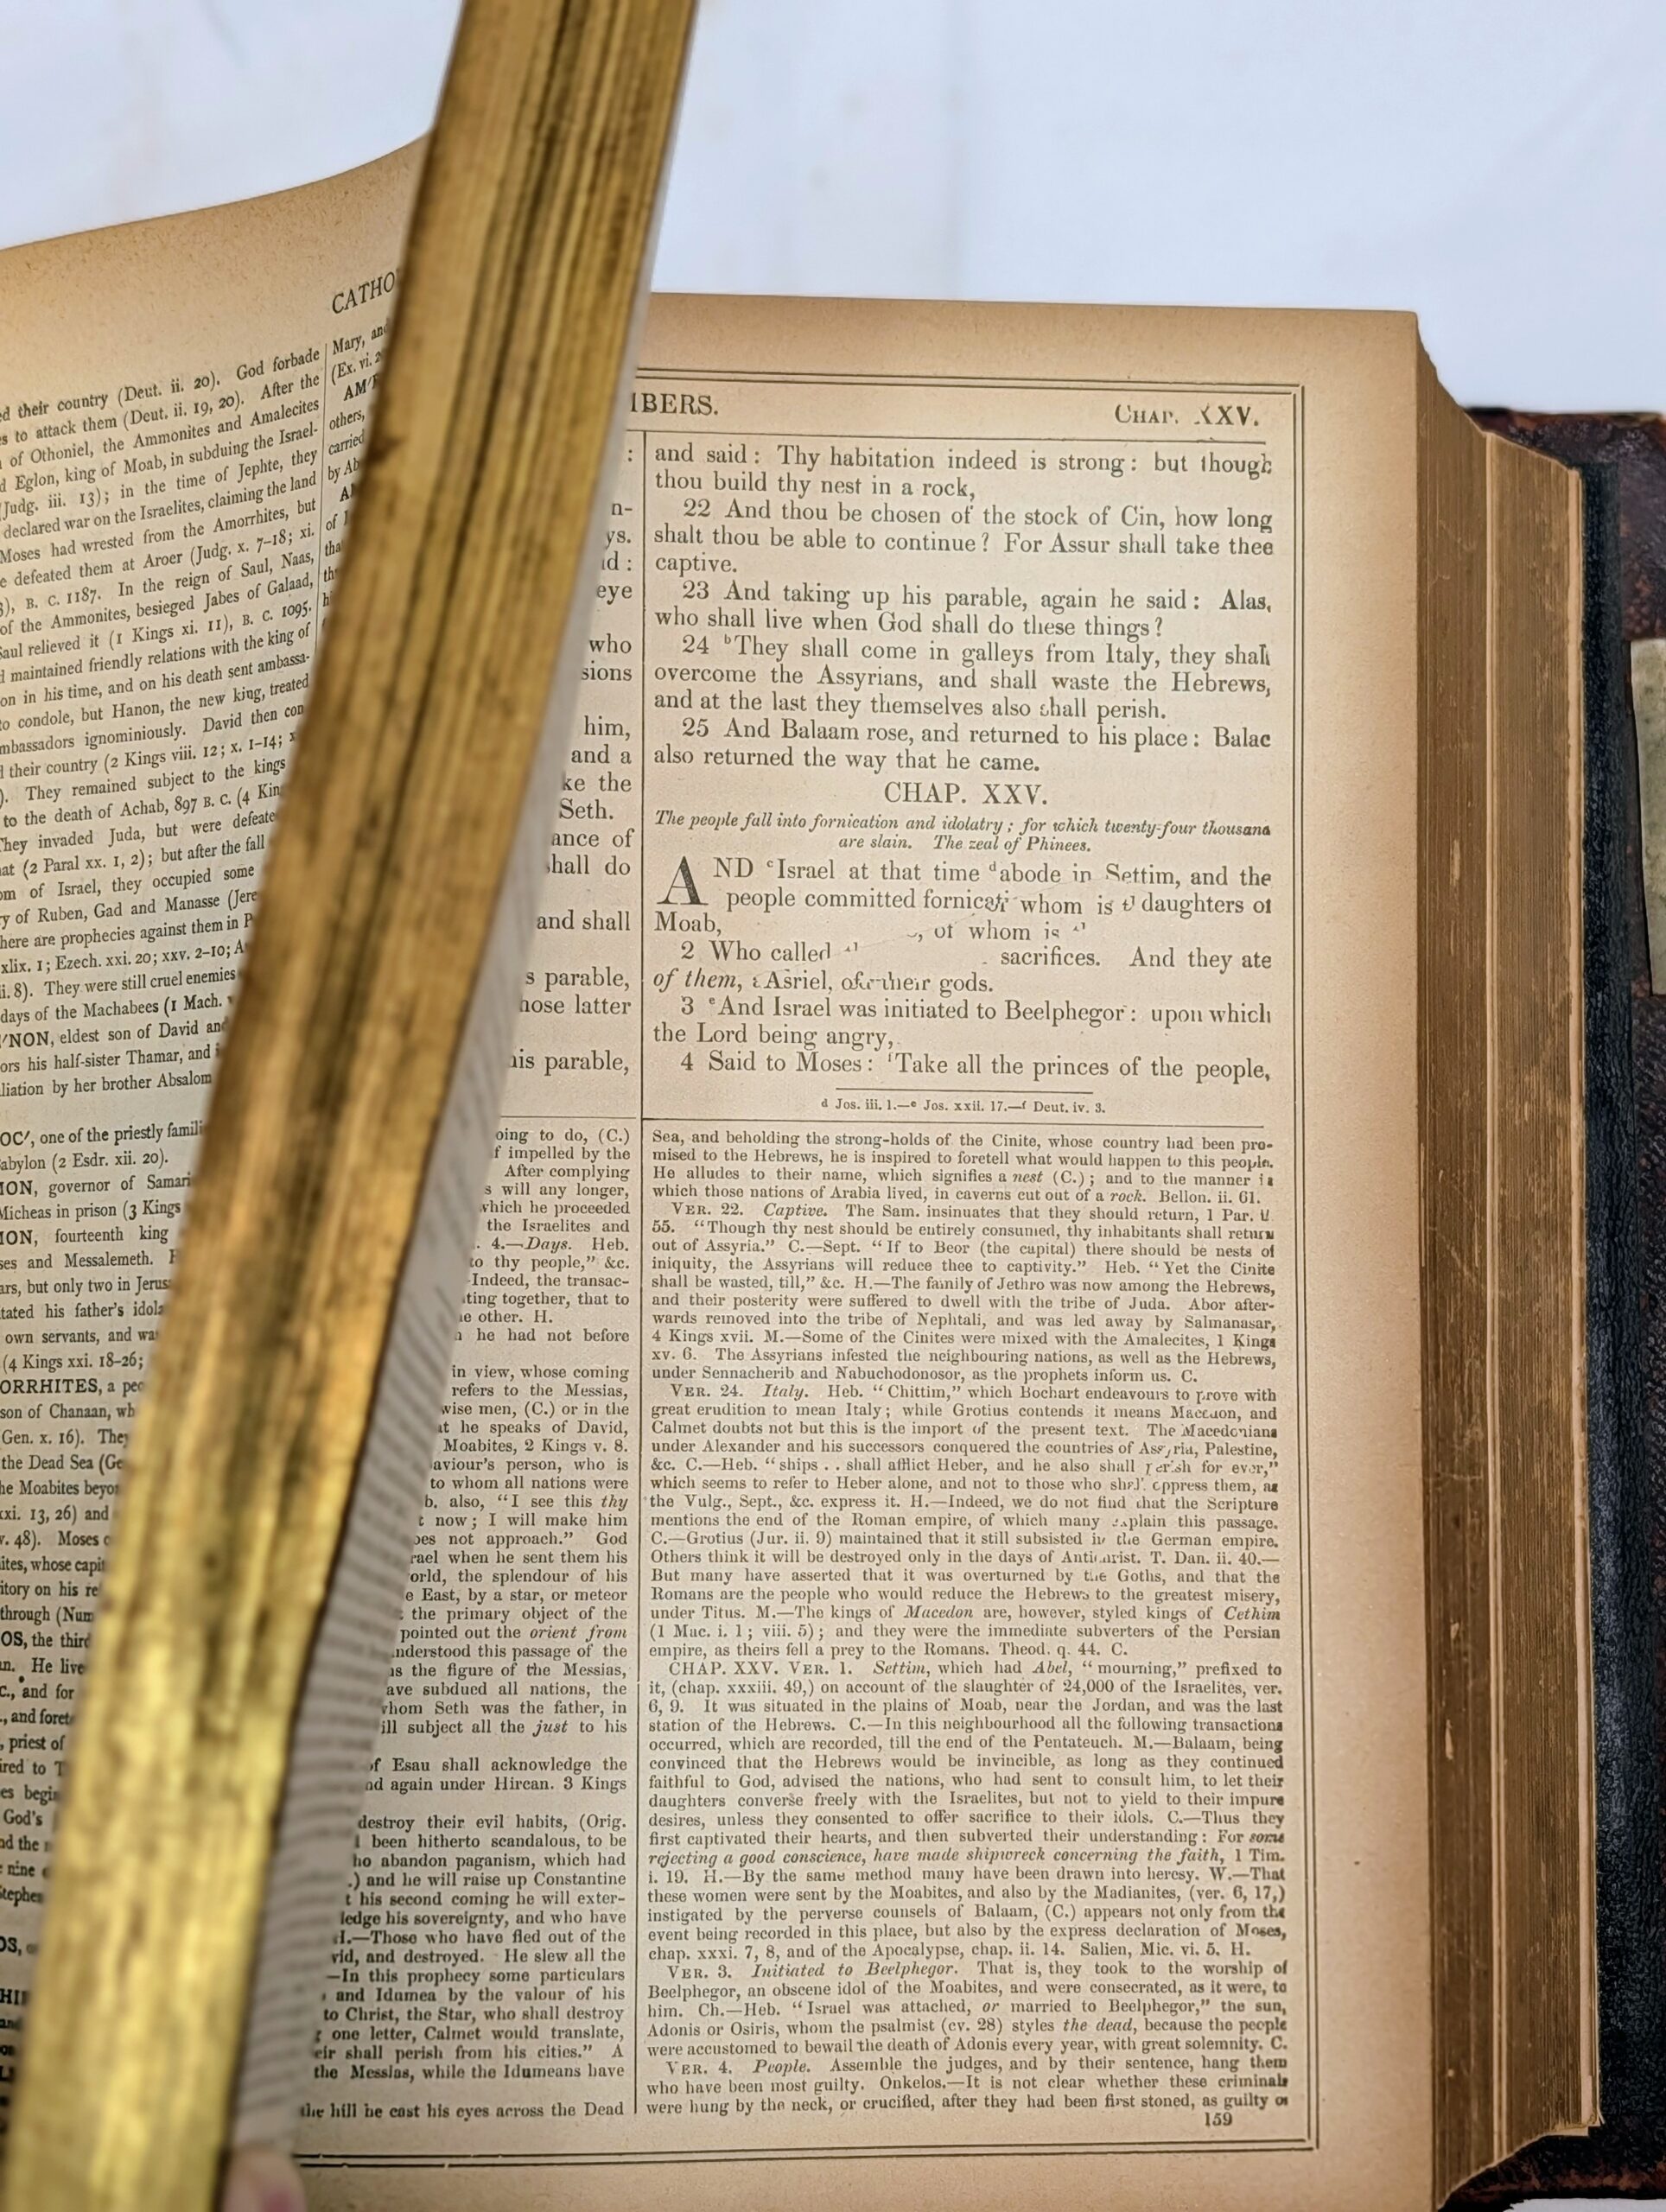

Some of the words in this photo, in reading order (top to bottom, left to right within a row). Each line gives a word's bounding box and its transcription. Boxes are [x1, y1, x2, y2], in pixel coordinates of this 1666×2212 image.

[332, 271, 395, 314] CATHO
[333, 335, 365, 355] Mary,
[18, 401, 49, 418] their
[57, 394, 108, 411] country
[118, 384, 162, 408] (Deut.
[171, 378, 184, 393] ii.
[194, 371, 219, 391] 20).
[237, 360, 264, 380] God
[273, 347, 320, 372] forbade
[329, 410, 365, 430] others,
[10, 451, 24, 467] of
[30, 441, 93, 463] Othoniel,
[103, 438, 124, 453] the
[133, 425, 210, 448] Ammonites
[218, 415, 242, 433] and
[250, 400, 319, 426] Amalecites
[655, 442, 694, 462] and
[777, 445, 820, 472] Thy
[830, 446, 934, 468] habitation
[948, 448, 1016, 470] indeed
[1031, 450, 1046, 470] is
[1154, 451, 1187, 473] but
[656, 468, 702, 489] thou
[714, 470, 766, 492] build
[778, 472, 811, 499] thy
[821, 479, 862, 494] nest
[872, 475, 891, 494] in
[902, 483, 913, 495] a
[923, 477, 975, 502] rock,
[684, 499, 710, 517] 22
[725, 498, 771, 518] And
[782, 499, 828, 520] thou
[838, 501, 862, 522] be
[871, 503, 940, 524] chosen
[951, 505, 973, 524] of
[983, 505, 1015, 524] the
[1025, 505, 1078, 525] stock
[1089, 505, 1111, 525] of
[1122, 505, 1165, 531] Cin,
[1175, 506, 1218, 526] how
[1227, 507, 1272, 533] long
[654, 523, 703, 543] shalt
[712, 524, 760, 545] thou
[770, 527, 794, 547] be
[804, 528, 846, 549] able
[855, 533, 875, 550] to
[1004, 532, 1042, 552] For
[1049, 532, 1110, 553] Assur
[1119, 533, 1166, 553] shall
[1176, 535, 1219, 555] take
[1229, 537, 1273, 556] thee
[656, 552, 736, 577] captive.
[588, 633, 632, 654] who
[584, 715, 630, 741] him,
[571, 743, 610, 764] and
[620, 751, 632, 764] a
[885, 782, 966, 804] CHAP.
[982, 784, 1046, 804] XXV.
[559, 798, 614, 820] Seth.
[655, 810, 684, 825] The
[688, 811, 738, 830] people
[741, 812, 773, 831] fall
[777, 812, 806, 828] into
[809, 813, 898, 832] fornication
[906, 816, 936, 830] and
[1019, 817, 1046, 836] for
[1053, 817, 1098, 832] which
[1105, 820, 1197, 839] twenty-four
[839, 838, 864, 848] are
[870, 834, 912, 849] slain.
[933, 835, 963, 849] The
[969, 836, 999, 850] zeal
[1004, 837, 1021, 855] of
[1027, 836, 1091, 852] Phinees.
[537, 909, 575, 930] and
[582, 910, 630, 931] shall
[544, 966, 629, 992] parable,
[653, 1021, 686, 1042] the
[696, 1022, 747, 1043] Lord
[759, 1024, 817, 1051] being
[827, 1032, 893, 1052] angry,
[652, 1129, 684, 1146] Sea,
[692, 1130, 719, 1143] and
[726, 1130, 800, 1148] beholding
[806, 1131, 830, 1144] the
[836, 1132, 930, 1149] strong-holds
[936, 1133, 951, 1146] of
[960, 1133, 982, 1147] the
[992, 1134, 1040, 1150] Cinite,
[1048, 1135, 1092, 1147] whose
[1103, 1137, 1160, 1153] country
[1167, 1136, 1193, 1149] had
[1202, 1137, 1235, 1150] been
[1241, 1141, 1273, 1154] pro-
[5, 1333, 34, 1344] own
[41, 1330, 99, 1345] servants,
[108, 1326, 131, 1342] and
[3, 1354, 17, 1374] (4
[22, 1354, 63, 1373] Kings
[67, 1352, 92, 1368] xxi.
[400, 1625, 458, 1643] pointed
[465, 1627, 490, 1639] out
[497, 1625, 521, 1638] the
[530, 1625, 577, 1638] orient
[585, 1624, 627, 1643] from
[649, 1774, 704, 1789] faithful
[715, 1776, 729, 1788] to
[739, 1774, 775, 1791] God,
[783, 1774, 839, 1788] advised
[850, 1773, 874, 1787] the
[886, 1773, 944, 1789] nations,
[951, 1772, 982, 1785] who
[994, 1771, 1021, 1785] had
[1033, 1773, 1062, 1785] sent
[1073, 1774, 1087, 1785] to
[1097, 1772, 1151, 1786] consult
[1160, 1773, 1195, 1790] him,
[1203, 1775, 1217, 1787] to
[1224, 1773, 1243, 1787] let
[1249, 1774, 1284, 1788] their
[358, 1815, 415, 1834] destroy
[427, 1815, 465, 1828] their
[476, 1814, 504, 1828] evil
[516, 1814, 567, 1832] habits,
[580, 1814, 626, 1832] (Orig.
[718, 1965, 732, 1979] 3.
[751, 1963, 824, 1978] Initiated
[838, 1963, 853, 1976] to
[865, 1961, 957, 1979] Beelphegor.
[977, 1961, 1014, 1974] That
[1025, 1961, 1041, 1978] is,
[1049, 1961, 1082, 1979] they
[1095, 1961, 1129, 1974] took
[1141, 1962, 1155, 1974] to
[1168, 1961, 1192, 1974] the
[1203, 1961, 1263, 1979] worship
[1273, 1960, 1288, 1974] of
[1205, 2112, 1232, 2126] 159
